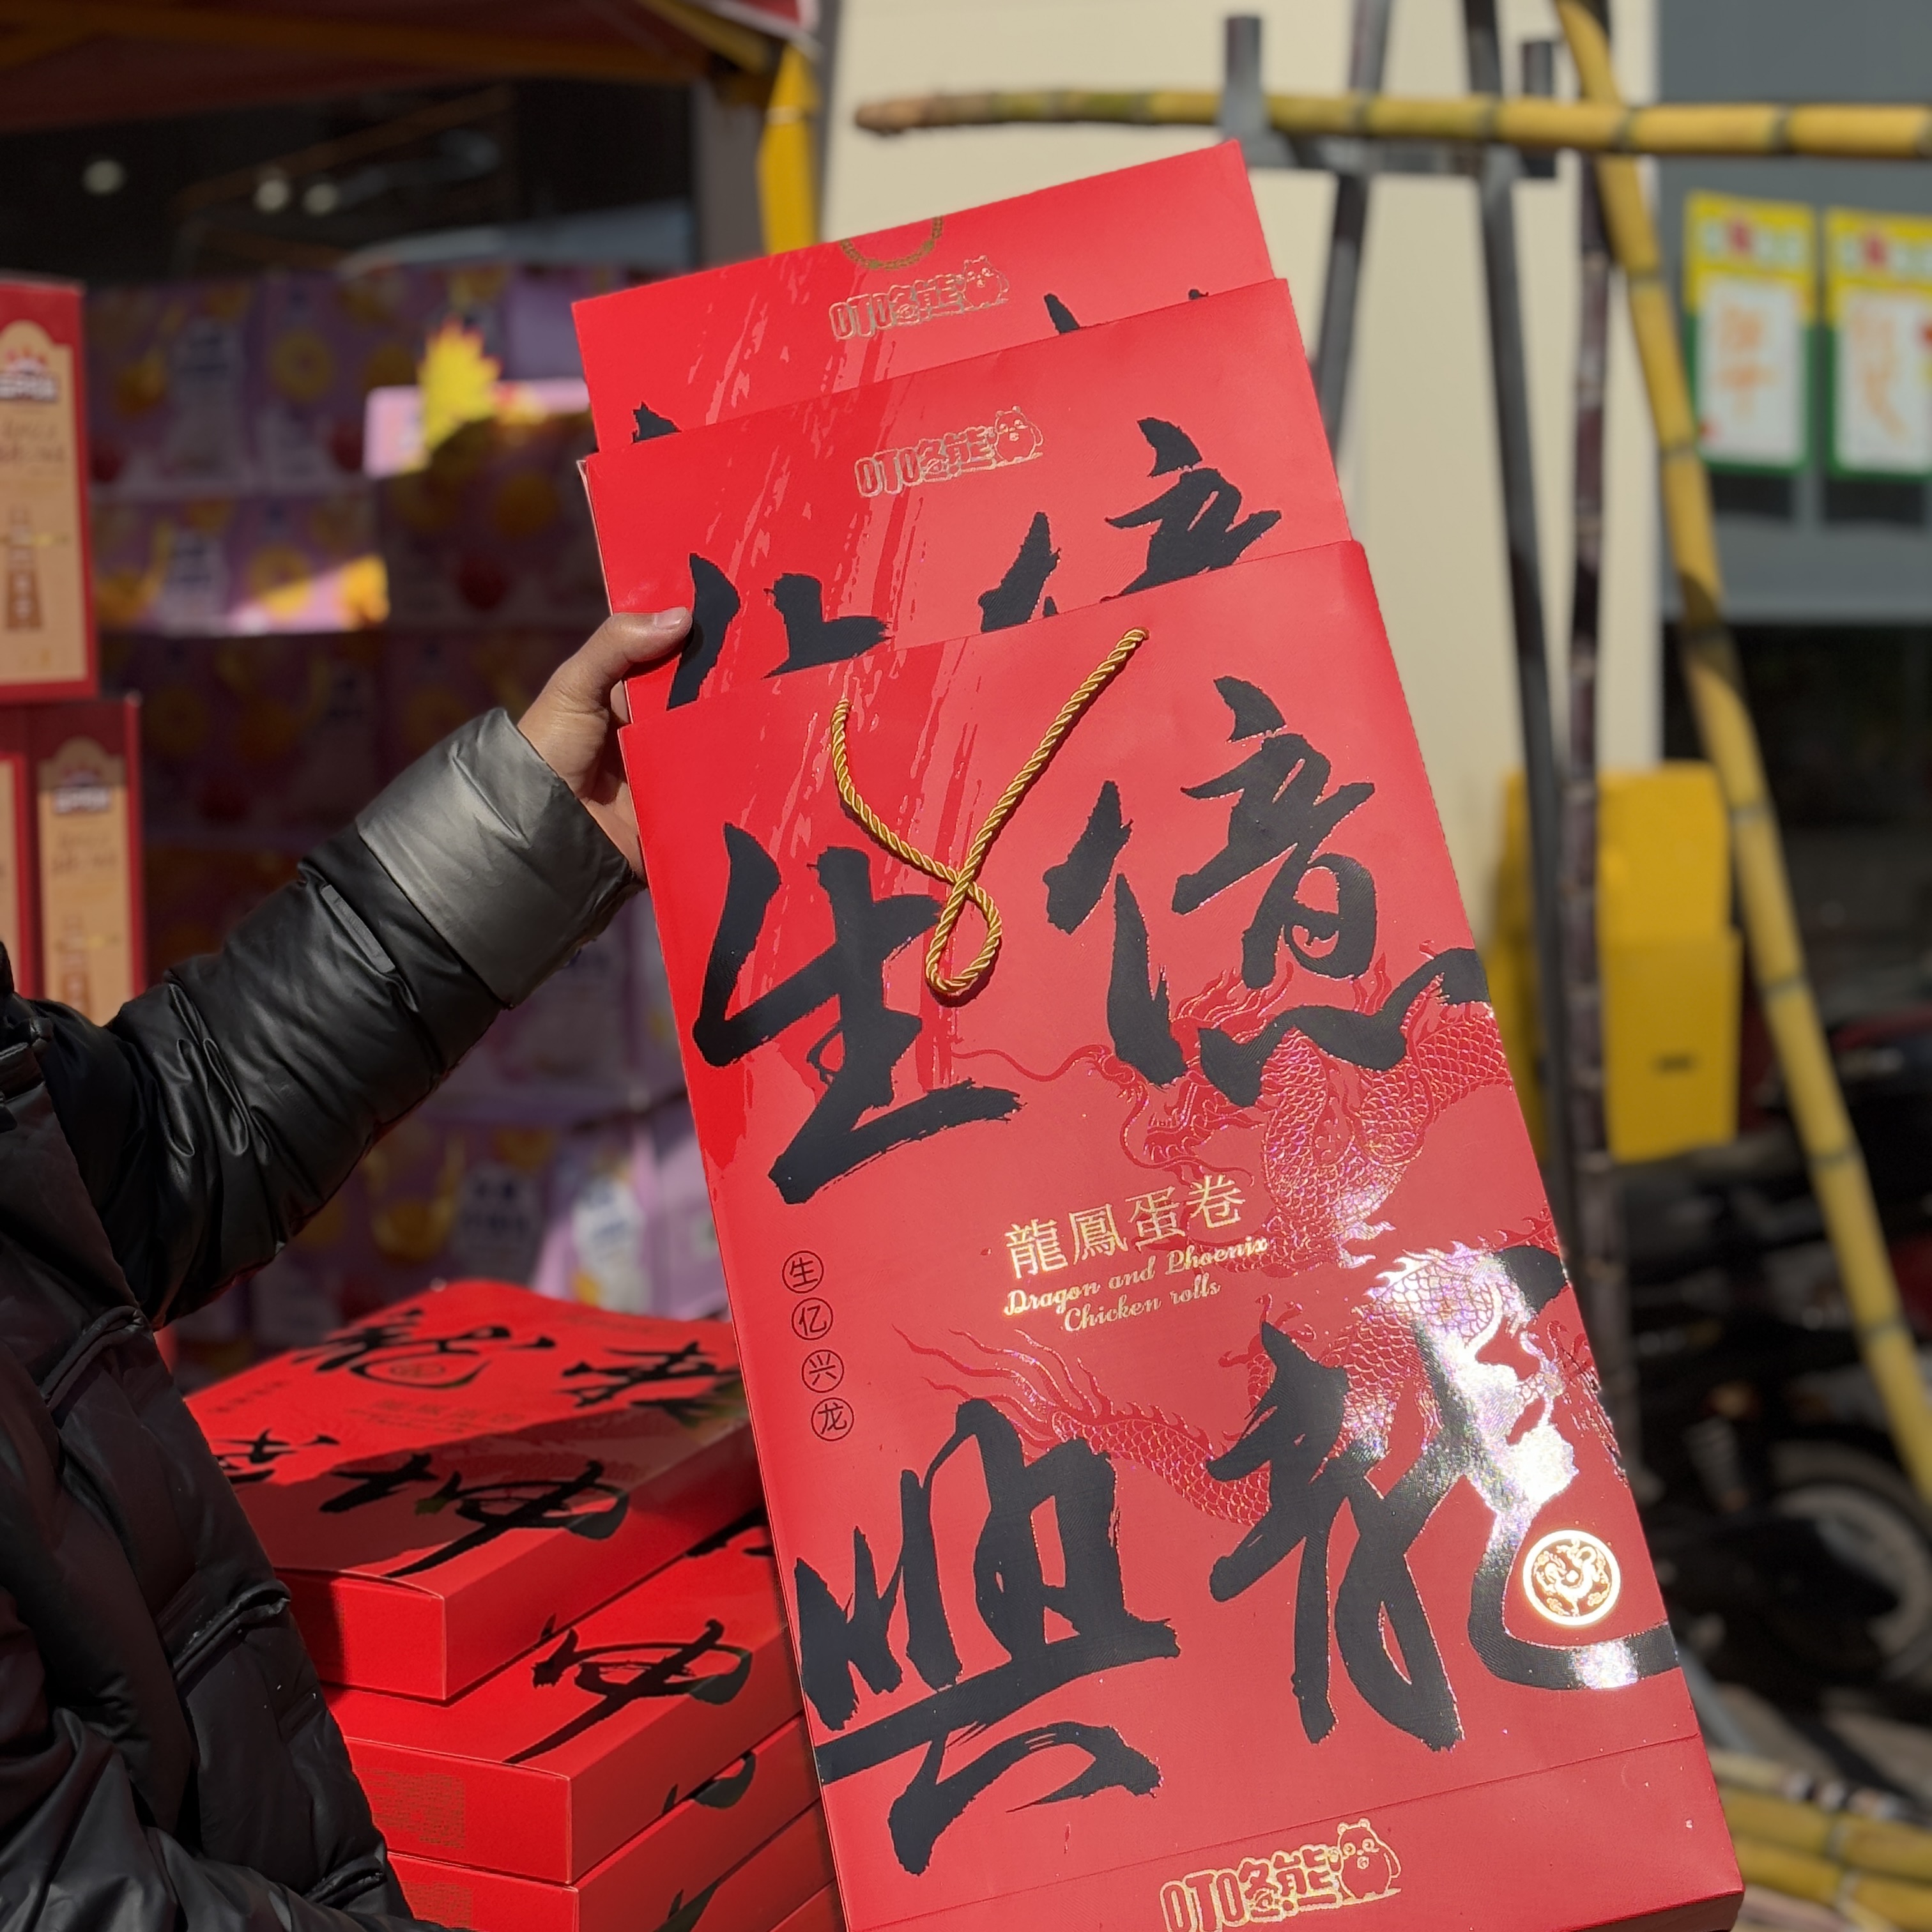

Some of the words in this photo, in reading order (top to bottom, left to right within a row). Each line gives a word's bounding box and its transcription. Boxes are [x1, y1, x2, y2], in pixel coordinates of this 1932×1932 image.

[1003, 1174, 1246, 1279] 龍鳳蛋卷
[1002, 1276, 1101, 1317] Dragon
[1107, 1257, 1157, 1290] and
[1165, 1234, 1269, 1276] Phoenix
[1062, 1294, 1163, 1333] Chicken
[1170, 1273, 1222, 1306] rolls
[785, 1252, 852, 1440] 生亿兴龙
